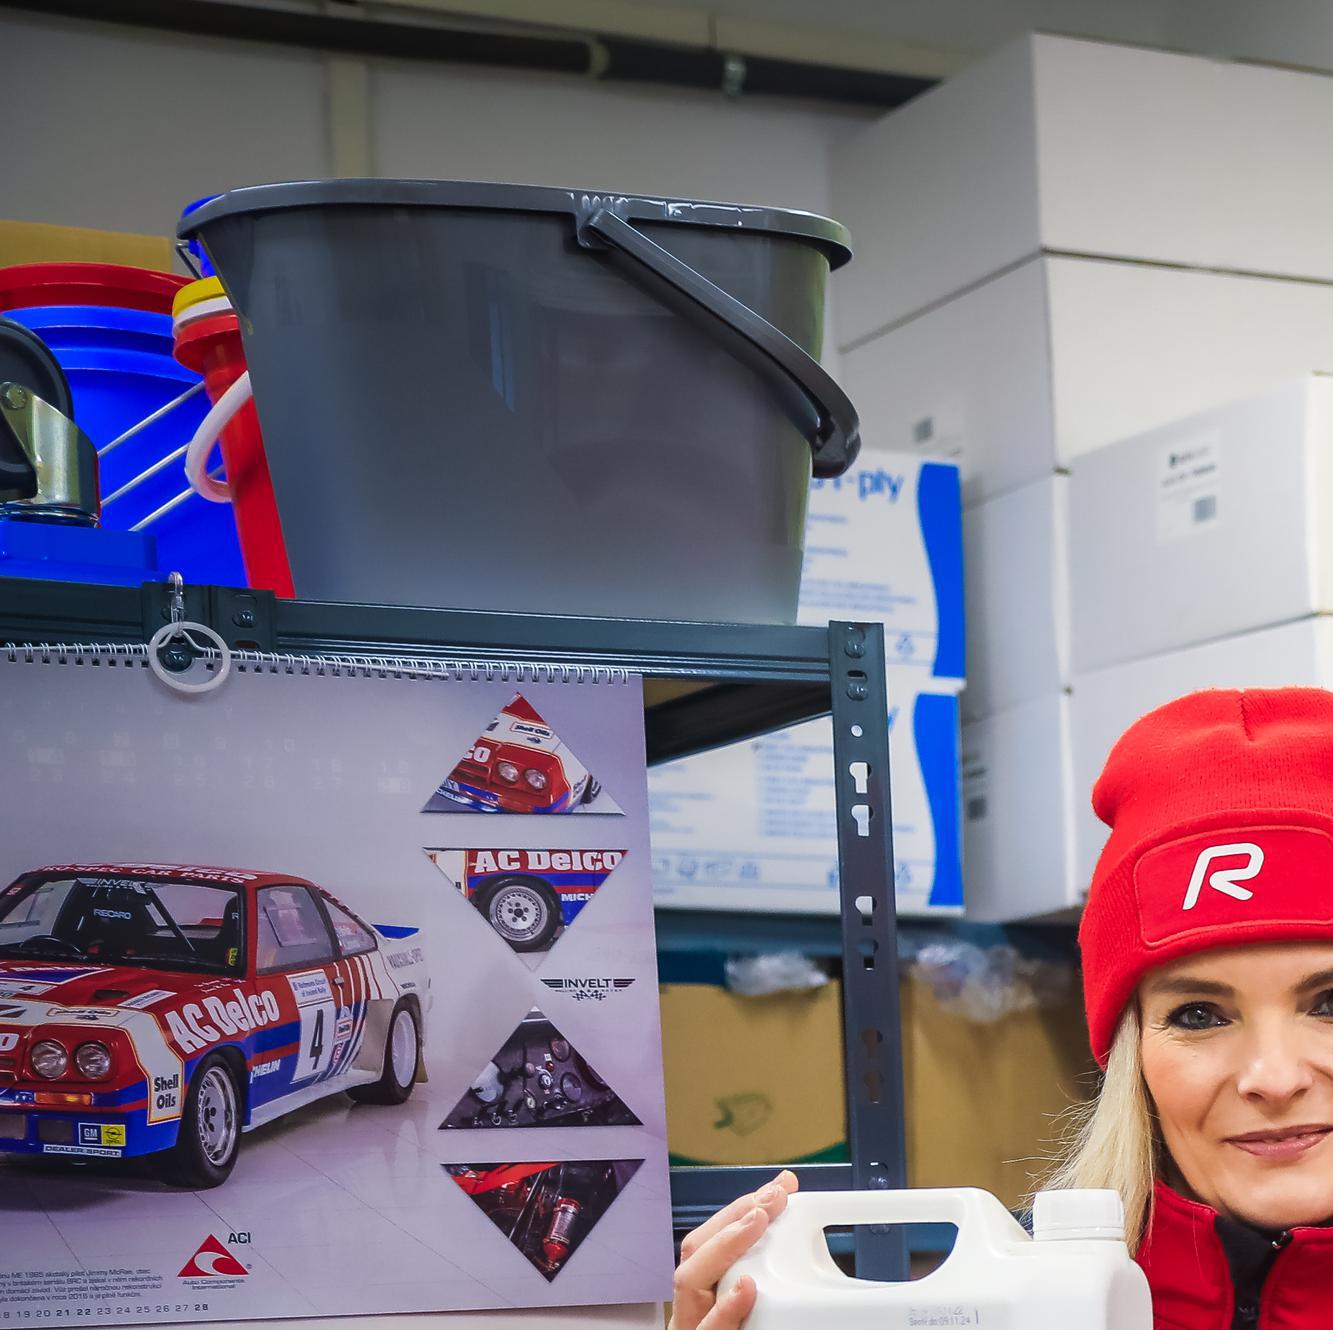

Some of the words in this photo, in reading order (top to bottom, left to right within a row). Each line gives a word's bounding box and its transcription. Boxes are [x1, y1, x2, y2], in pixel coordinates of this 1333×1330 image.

[474, 850, 520, 873] AC
[527, 850, 623, 871] Delco
[561, 893, 593, 903] MICH
[93, 908, 132, 920] RECARO
[564, 979, 612, 988] INVELT
[309, 1009, 324, 1070] 4
[153, 1074, 179, 1092] Shell
[156, 1095, 176, 1110] Oils
[84, 1128, 98, 1139] GM
[227, 1232, 251, 1245] ACI
[17, 1310, 30, 1318] 19
[76, 1308, 91, 1316] 22
[97, 1307, 111, 1315] 23
[175, 1304, 189, 1312] 27
[194, 1303, 209, 1311] 28
